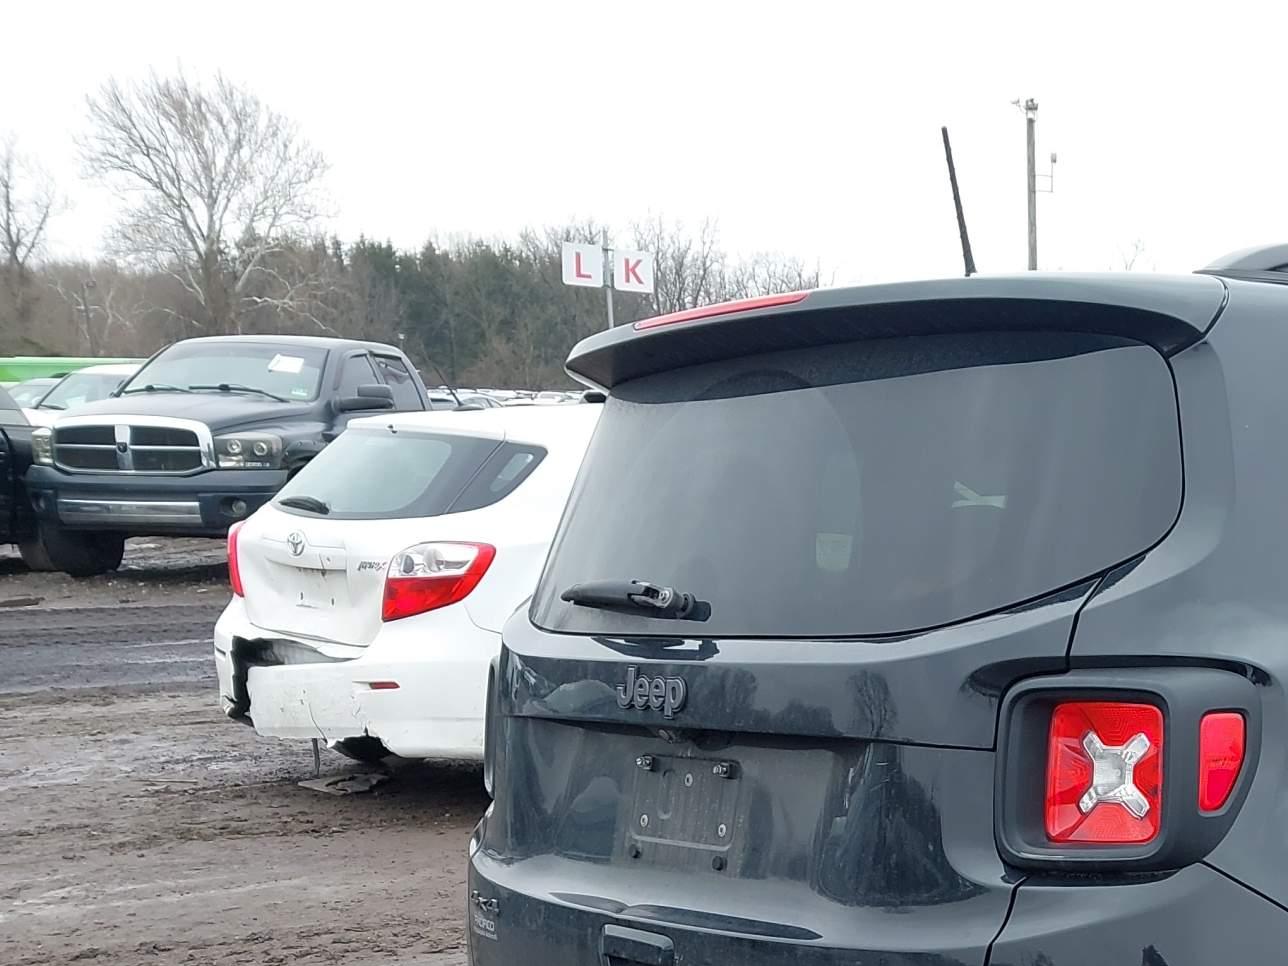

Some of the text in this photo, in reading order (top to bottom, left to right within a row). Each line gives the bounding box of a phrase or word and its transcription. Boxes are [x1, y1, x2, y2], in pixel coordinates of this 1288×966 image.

[575, 251, 592, 279] L
[624, 257, 645, 285] K
[616, 664, 687, 719] Jeep
